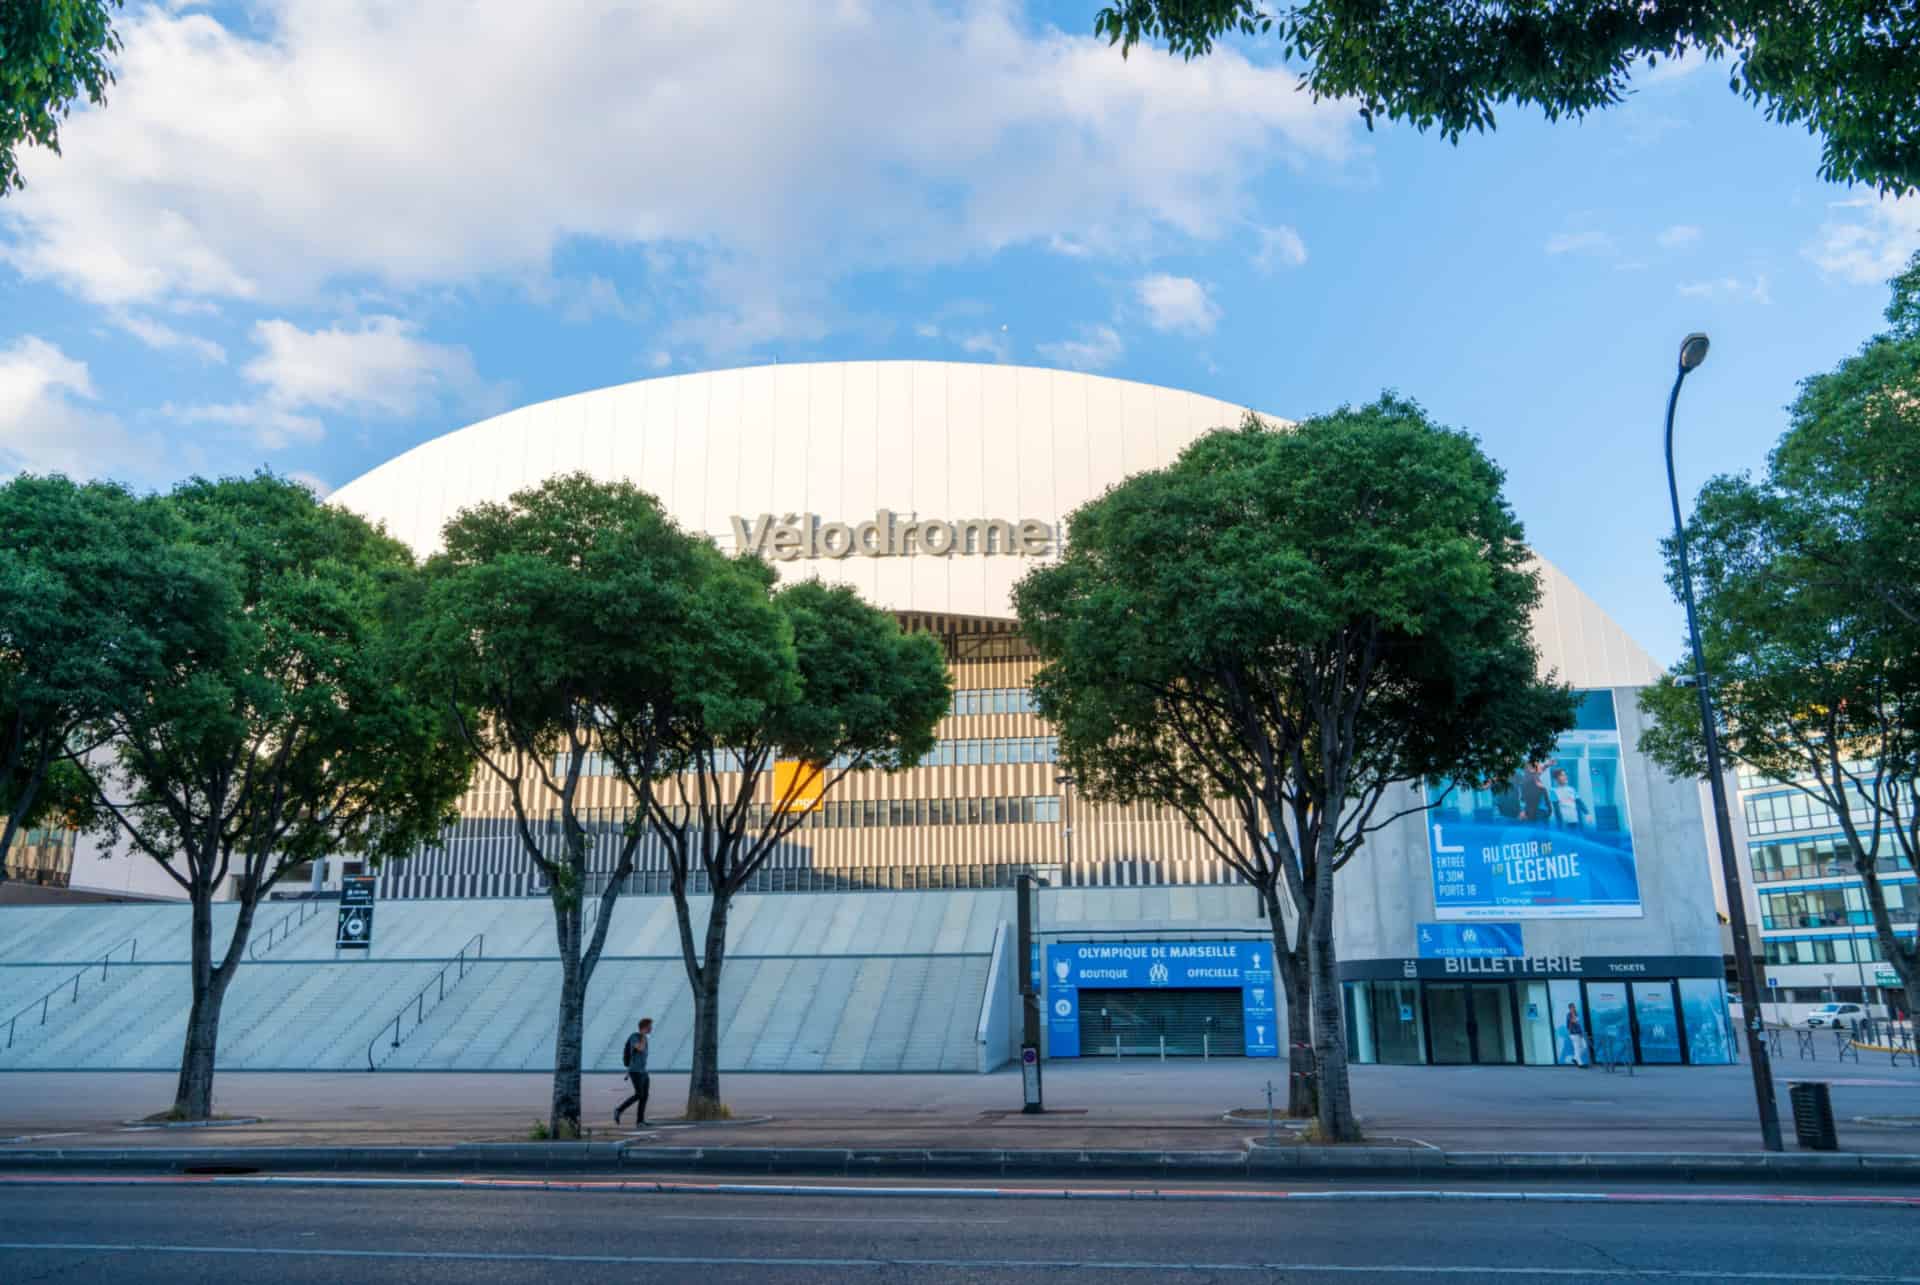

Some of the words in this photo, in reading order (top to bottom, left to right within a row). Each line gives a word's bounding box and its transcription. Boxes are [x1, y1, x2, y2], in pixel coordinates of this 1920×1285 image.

[730, 509, 1051, 561] Vélodrome
[1482, 846, 1500, 864] AU
[1439, 884, 1466, 897] PORTE
[1078, 947, 1148, 959] OLYMPIQUE
[1151, 947, 1167, 958] DE
[1170, 946, 1237, 958] MARSEILLE
[1444, 956, 1583, 973] BILLETTERIE
[1607, 963, 1646, 973] TICKETS
[1079, 969, 1129, 979] BOUTIQUE
[1187, 968, 1239, 978] OFFICIELLE
